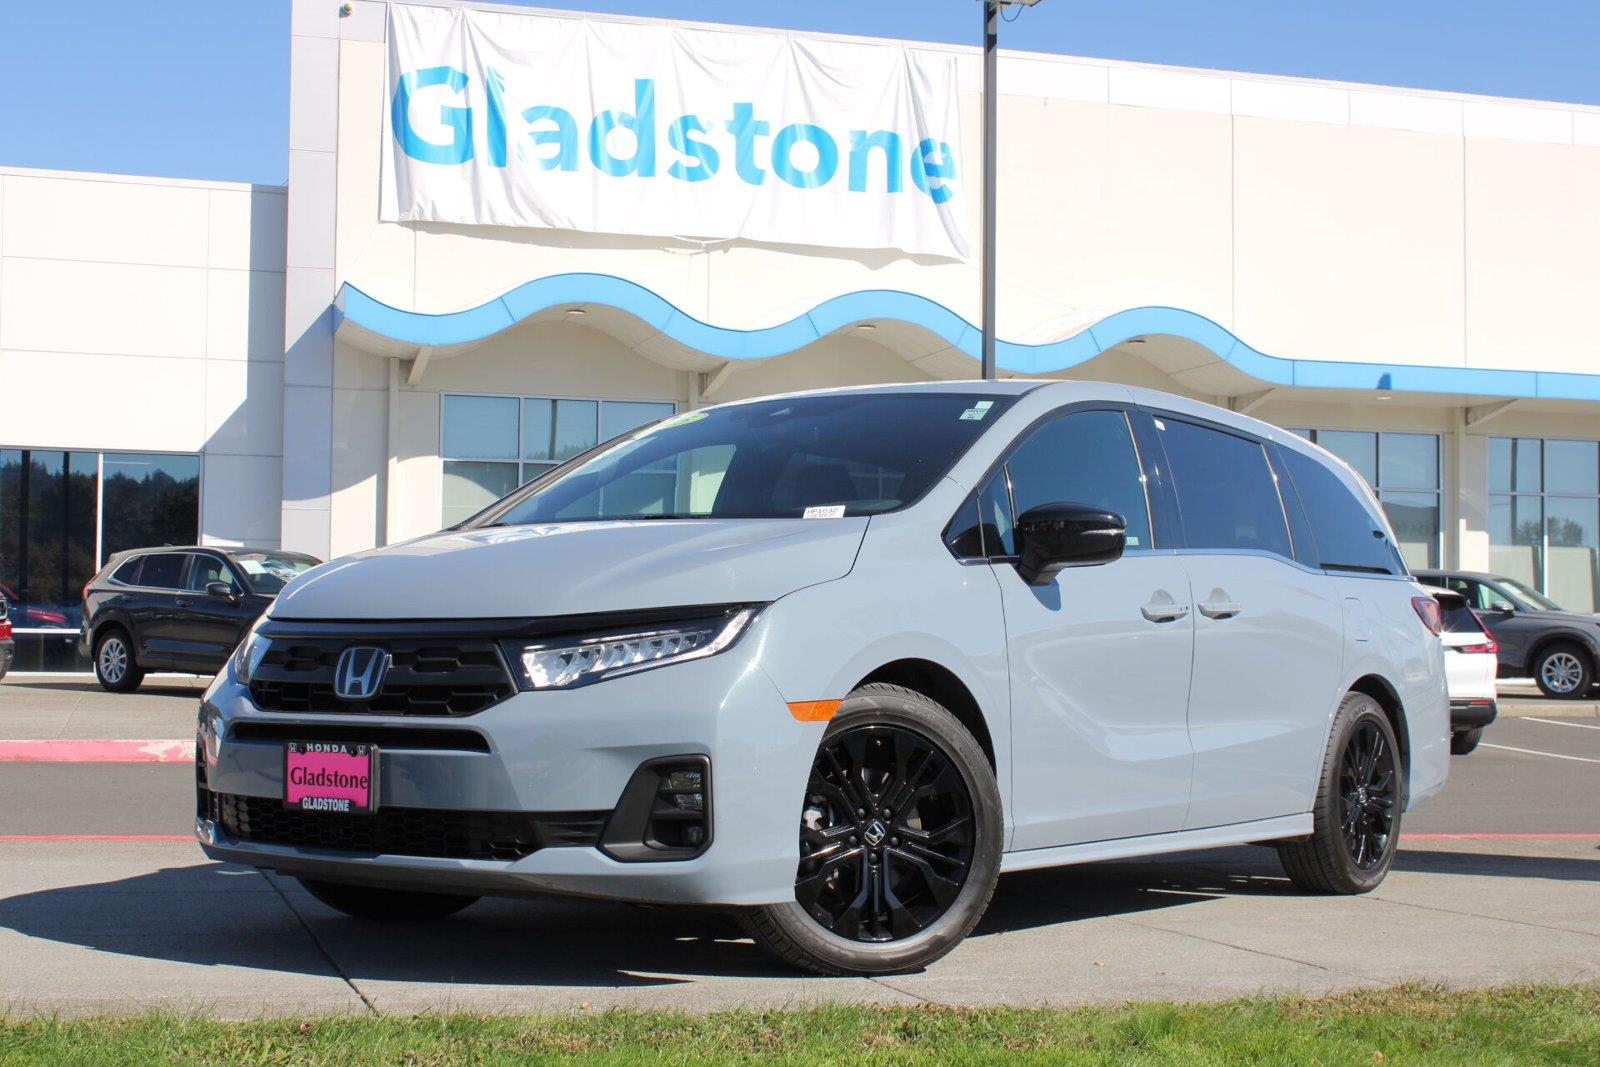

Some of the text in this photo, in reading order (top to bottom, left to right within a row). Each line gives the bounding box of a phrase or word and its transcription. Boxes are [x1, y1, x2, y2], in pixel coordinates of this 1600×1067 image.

[391, 66, 957, 204] Gladstone
[306, 743, 348, 753] HONDA
[290, 766, 369, 789] Gladstone
[302, 797, 350, 812] GLADSTONE
